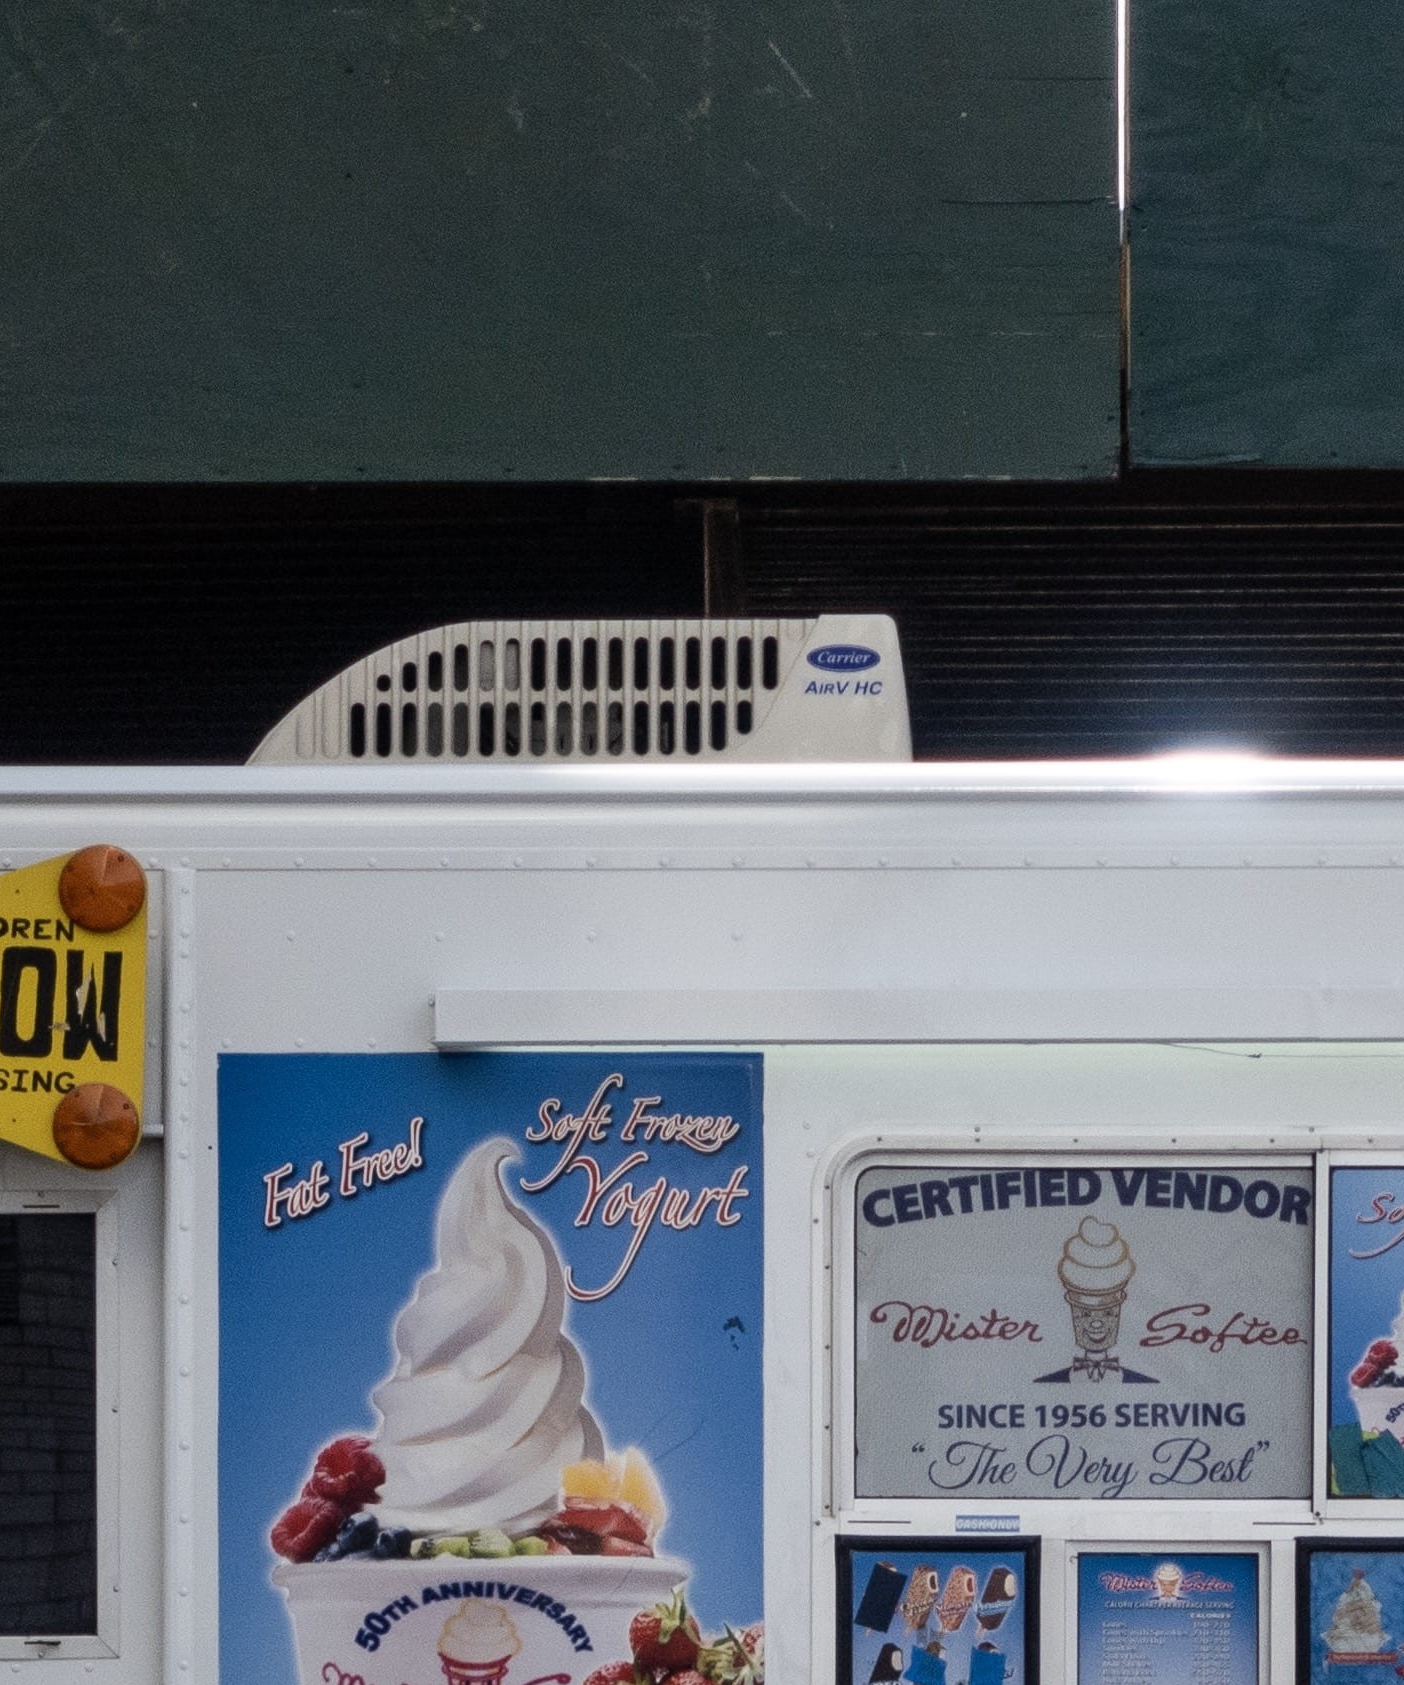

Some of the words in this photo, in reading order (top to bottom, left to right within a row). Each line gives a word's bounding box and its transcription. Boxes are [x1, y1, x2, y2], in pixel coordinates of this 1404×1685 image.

[817, 650, 872, 664] Carrier
[855, 681, 883, 695] HC
[520, 1072, 624, 1192] Soft
[621, 1096, 739, 1153] Frozen
[262, 1162, 330, 1228] Fat
[338, 1117, 424, 1196] Free!
[862, 1170, 1102, 1228] CERTIFIED
[1111, 1168, 1312, 1226] VENDOR
[564, 1151, 749, 1300] Yogurt
[869, 1301, 1044, 1348] Mister
[1139, 1304, 1309, 1353] Softee
[938, 1404, 1025, 1429] SINCE
[1035, 1404, 1107, 1429] 1956
[1114, 1402, 1247, 1428] SERVING
[1026, 1434, 1140, 1498] Very
[1100, 1572, 1158, 1593] Mister
[1179, 1571, 1234, 1592] Softee
[354, 1596, 419, 1653] 50TH
[421, 1580, 594, 1654] ANNIVERSARY
